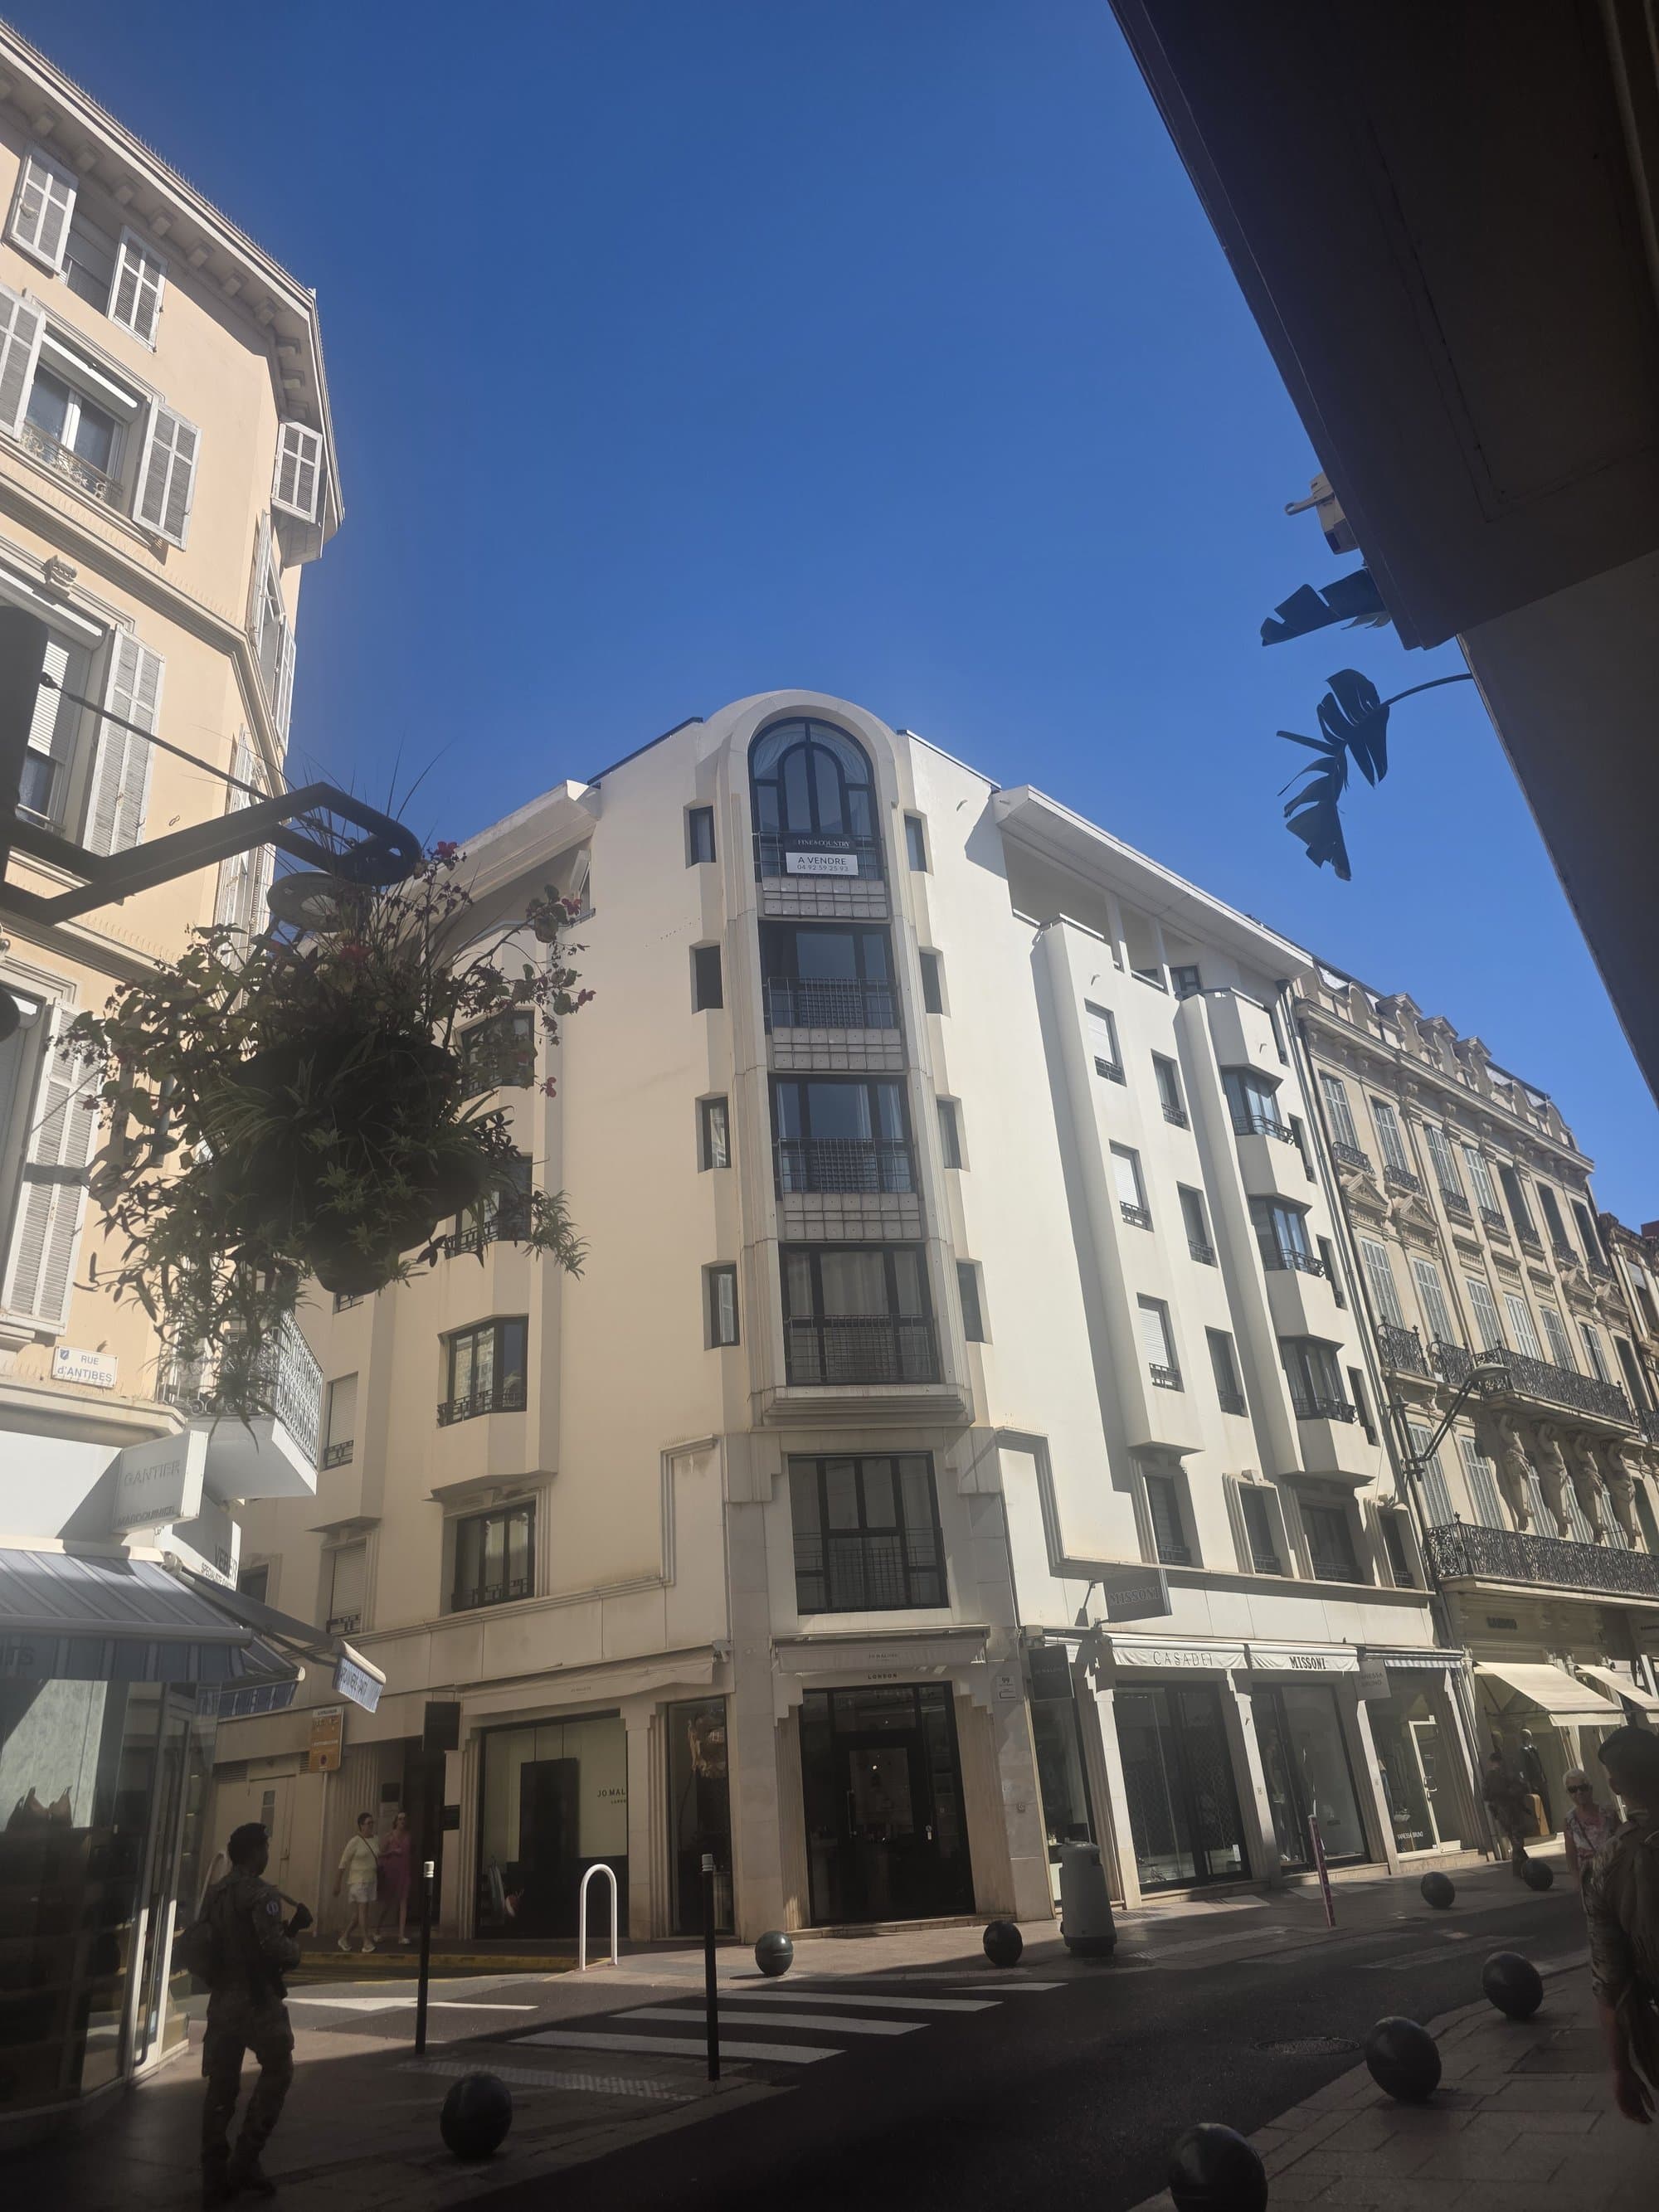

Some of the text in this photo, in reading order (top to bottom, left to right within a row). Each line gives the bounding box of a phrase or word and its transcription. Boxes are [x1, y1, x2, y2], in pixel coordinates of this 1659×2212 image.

[807, 857, 847, 865] VENDRE
[80, 1354, 100, 1365] RUE
[57, 1366, 114, 1383] d'ANTIBES
[124, 1460, 181, 1486] GANTIER
[1109, 1586, 1160, 1606] MISSONI
[1153, 1651, 1213, 1666] CASADEI
[1289, 1656, 1326, 1670] MISSONI
